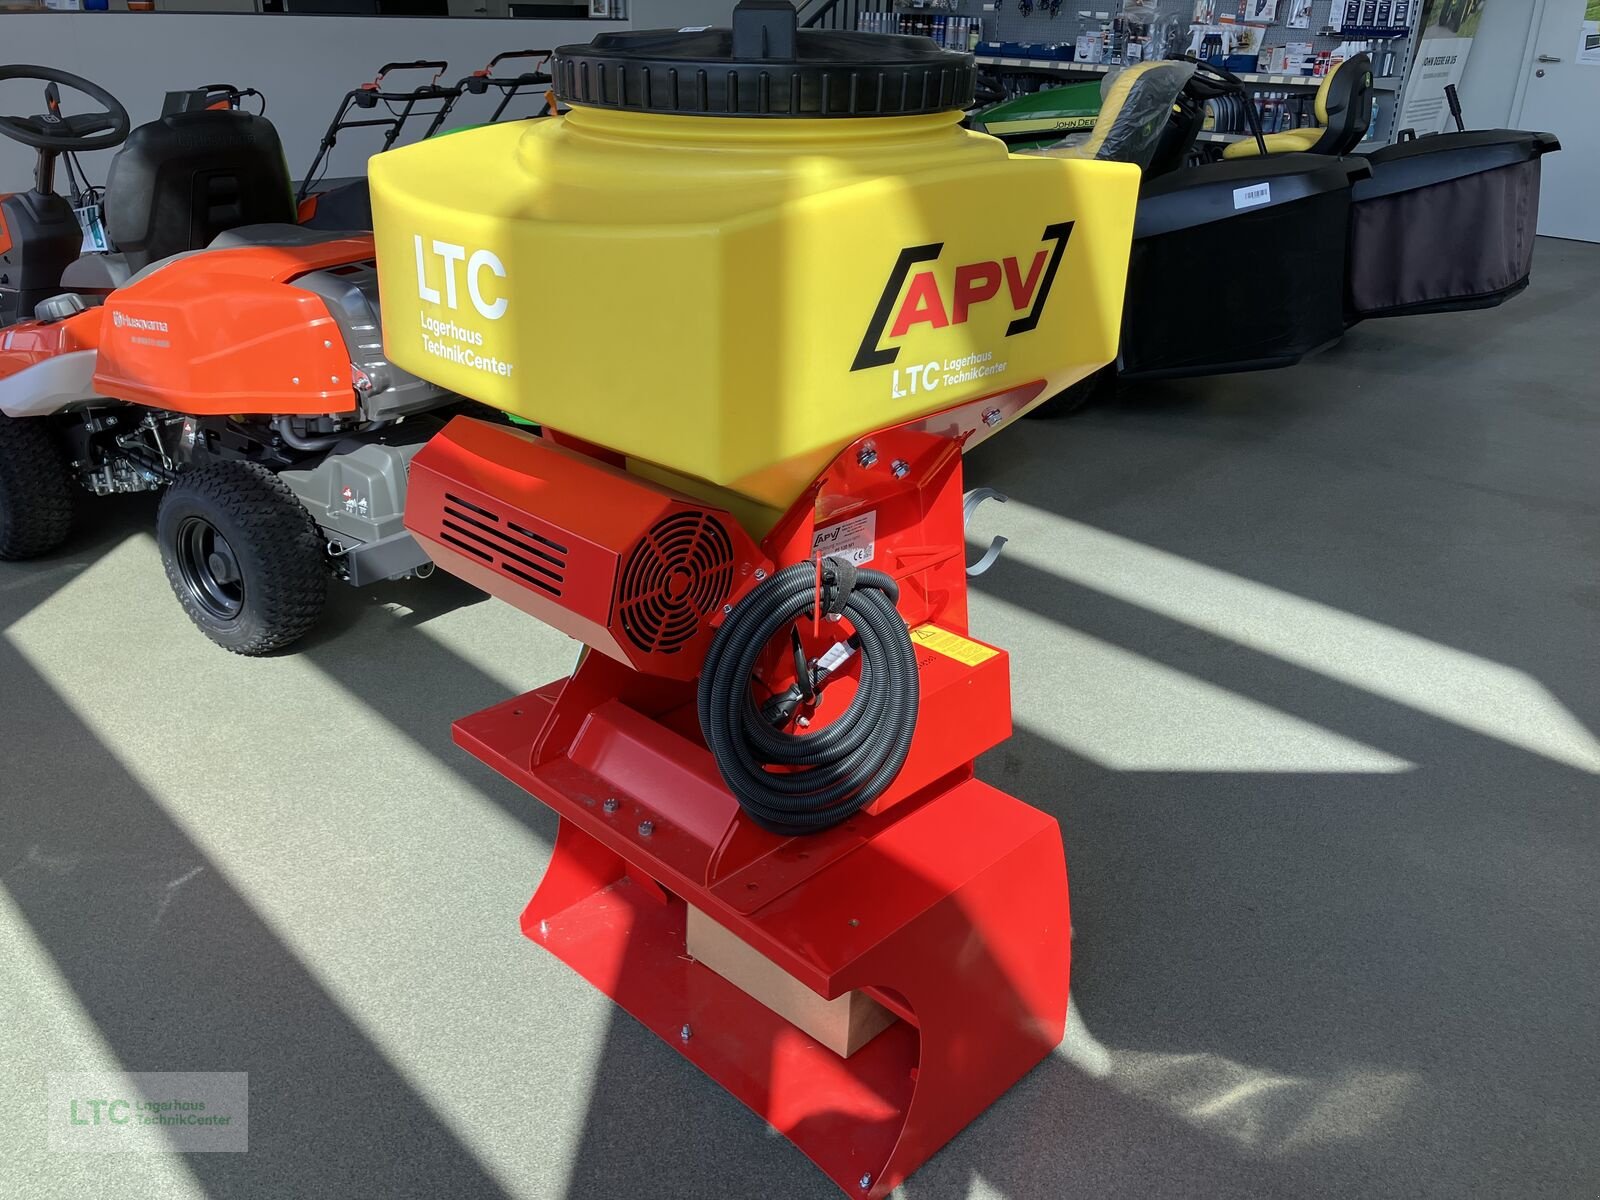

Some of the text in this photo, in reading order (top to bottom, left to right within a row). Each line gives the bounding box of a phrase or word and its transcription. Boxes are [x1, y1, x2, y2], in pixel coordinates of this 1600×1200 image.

[1053, 121, 1077, 129] JOHN
[413, 233, 508, 320] LTC
[122, 314, 168, 332] Husqvarna
[420, 310, 483, 346] Lagerhaus
[422, 333, 514, 377] TechnikCenter
[943, 351, 993, 371] Lagerhaus
[891, 361, 941, 399] LTC
[942, 361, 1008, 387] TechnikCenter
